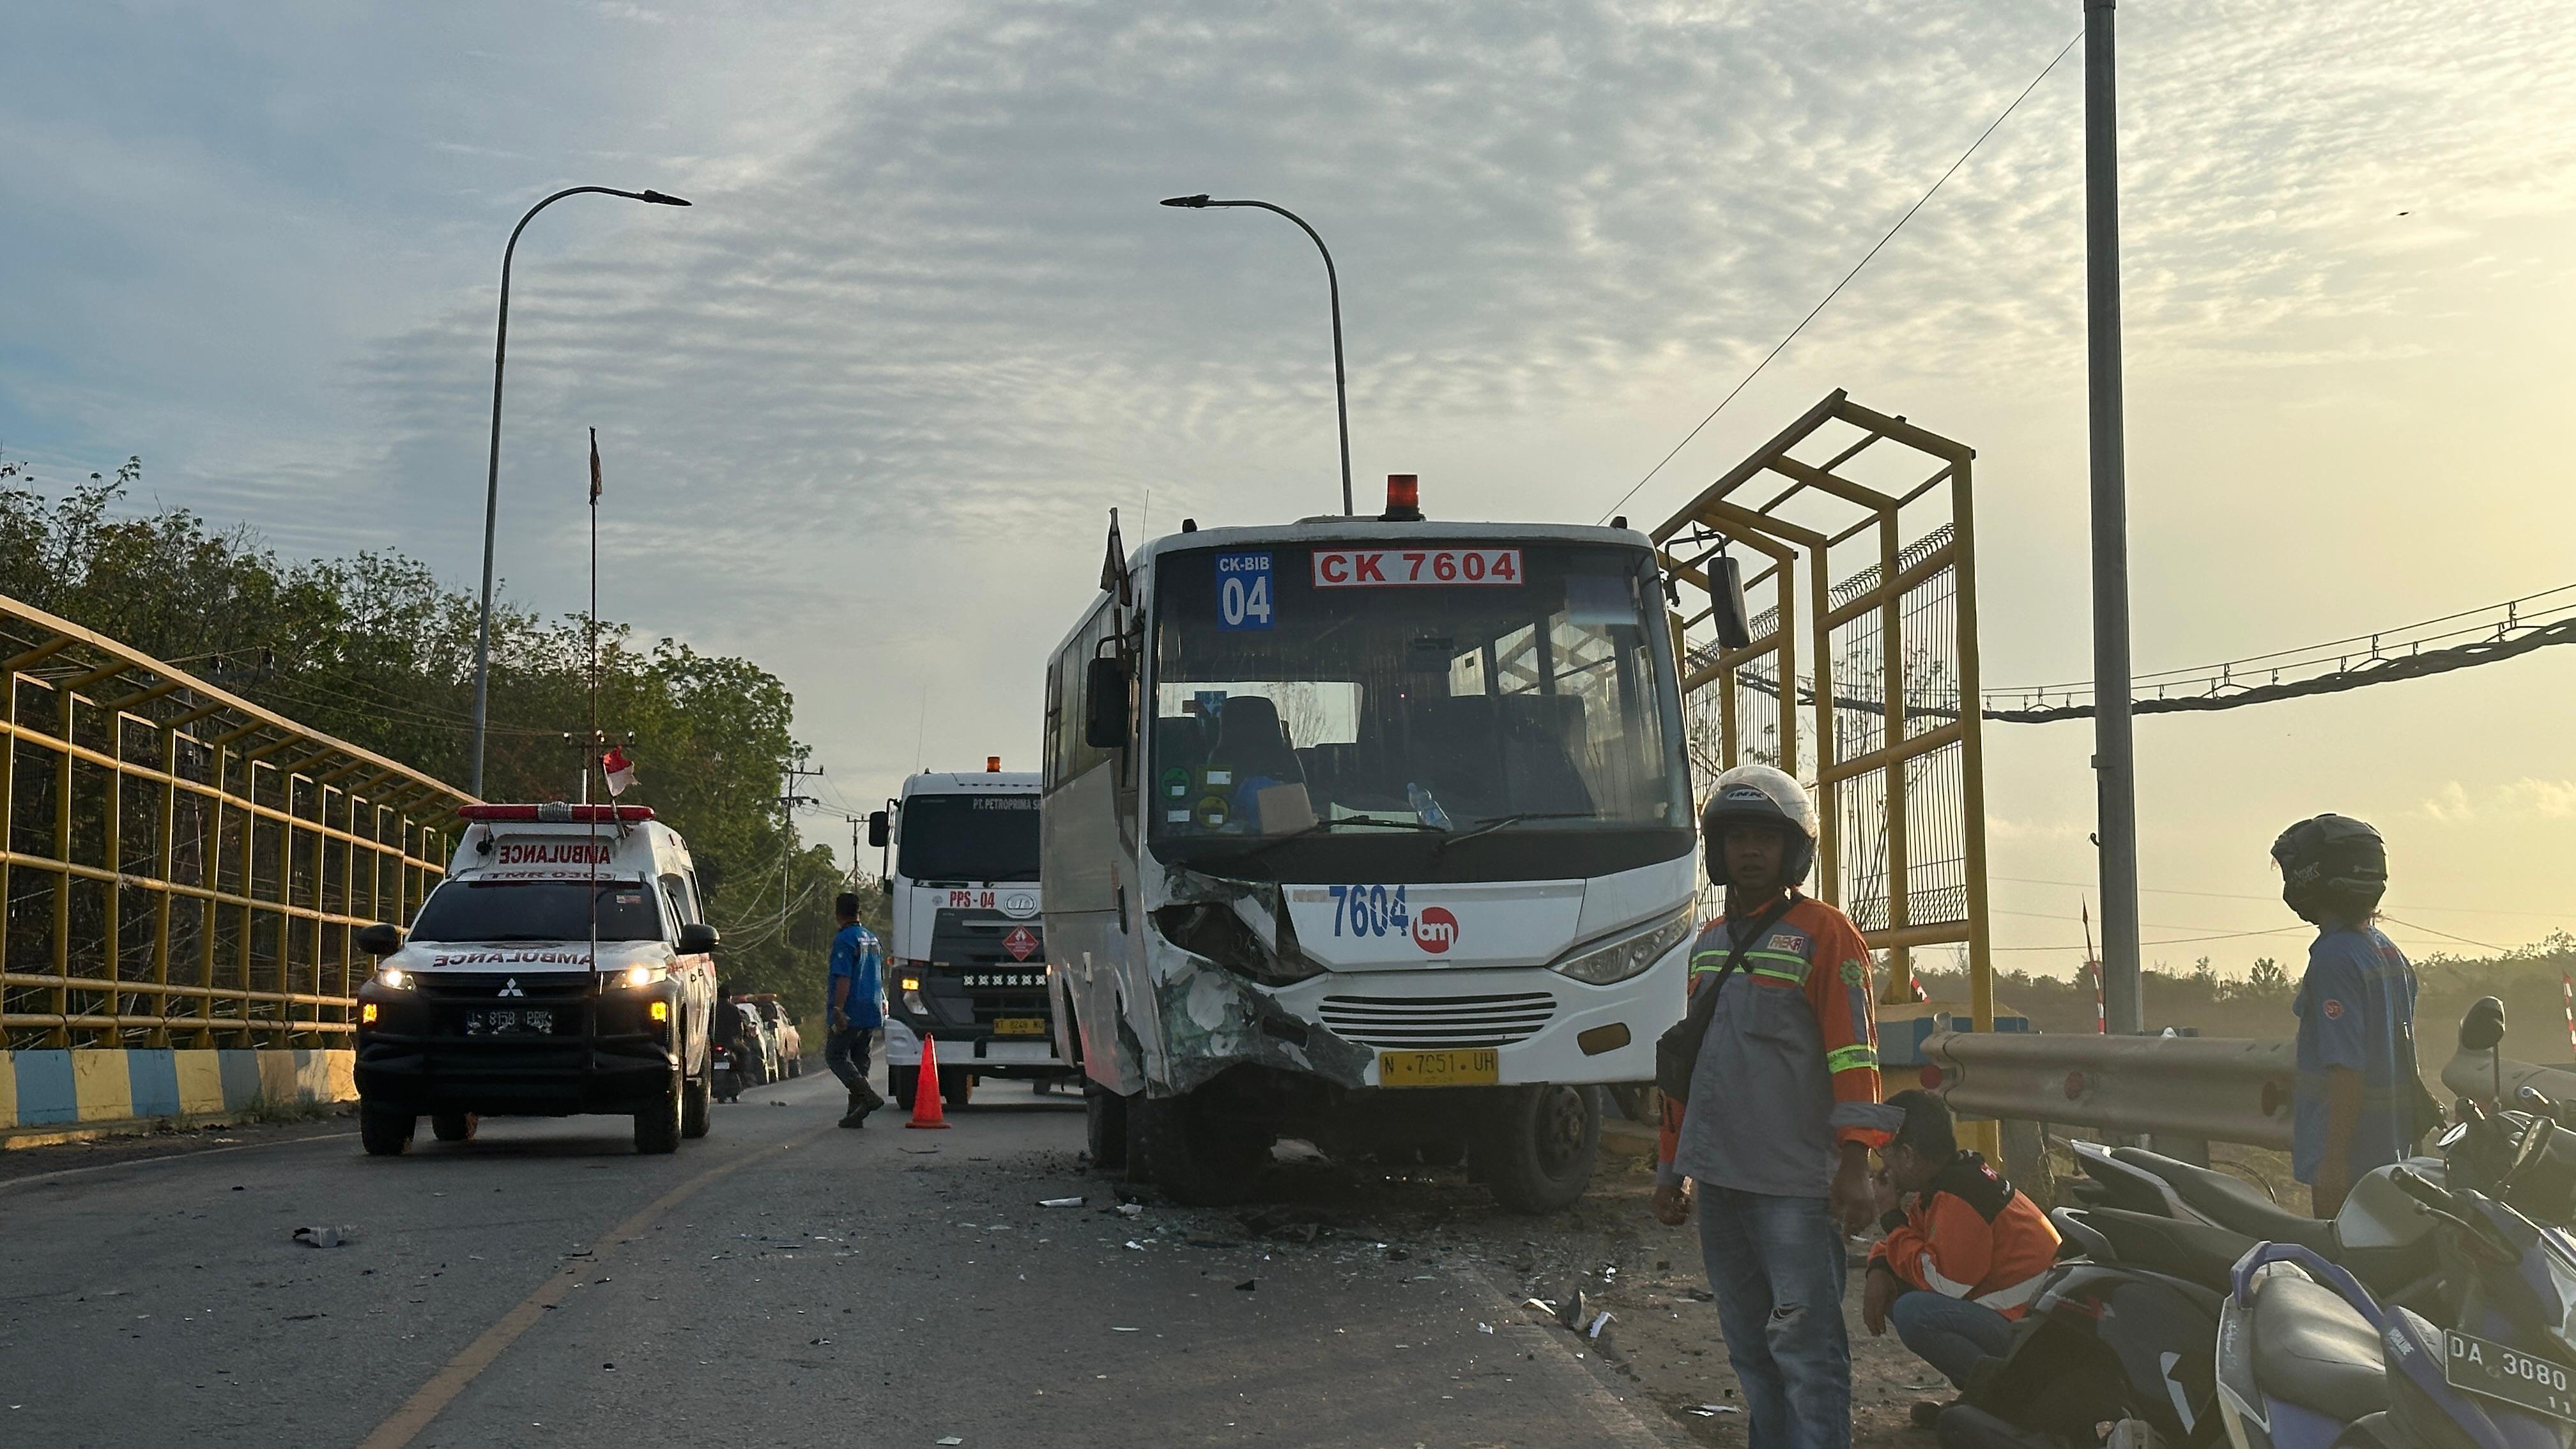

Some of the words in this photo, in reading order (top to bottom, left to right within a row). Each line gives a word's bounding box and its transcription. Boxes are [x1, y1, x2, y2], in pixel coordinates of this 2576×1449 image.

[1219, 556, 1270, 572] CK-BIB
[1321, 554, 1386, 583] CK
[1403, 553, 1515, 581] 7604
[1223, 576, 1270, 625] 04
[985, 799, 1031, 810] PETROPRIMA
[950, 891, 970, 907] PPS
[981, 891, 995, 908] 04
[1330, 884, 1409, 937] 7604
[1384, 1056, 1394, 1075] N
[1473, 1052, 1494, 1071] UH
[2450, 1335, 2483, 1365] DA
[2502, 1353, 2567, 1392] 3080
